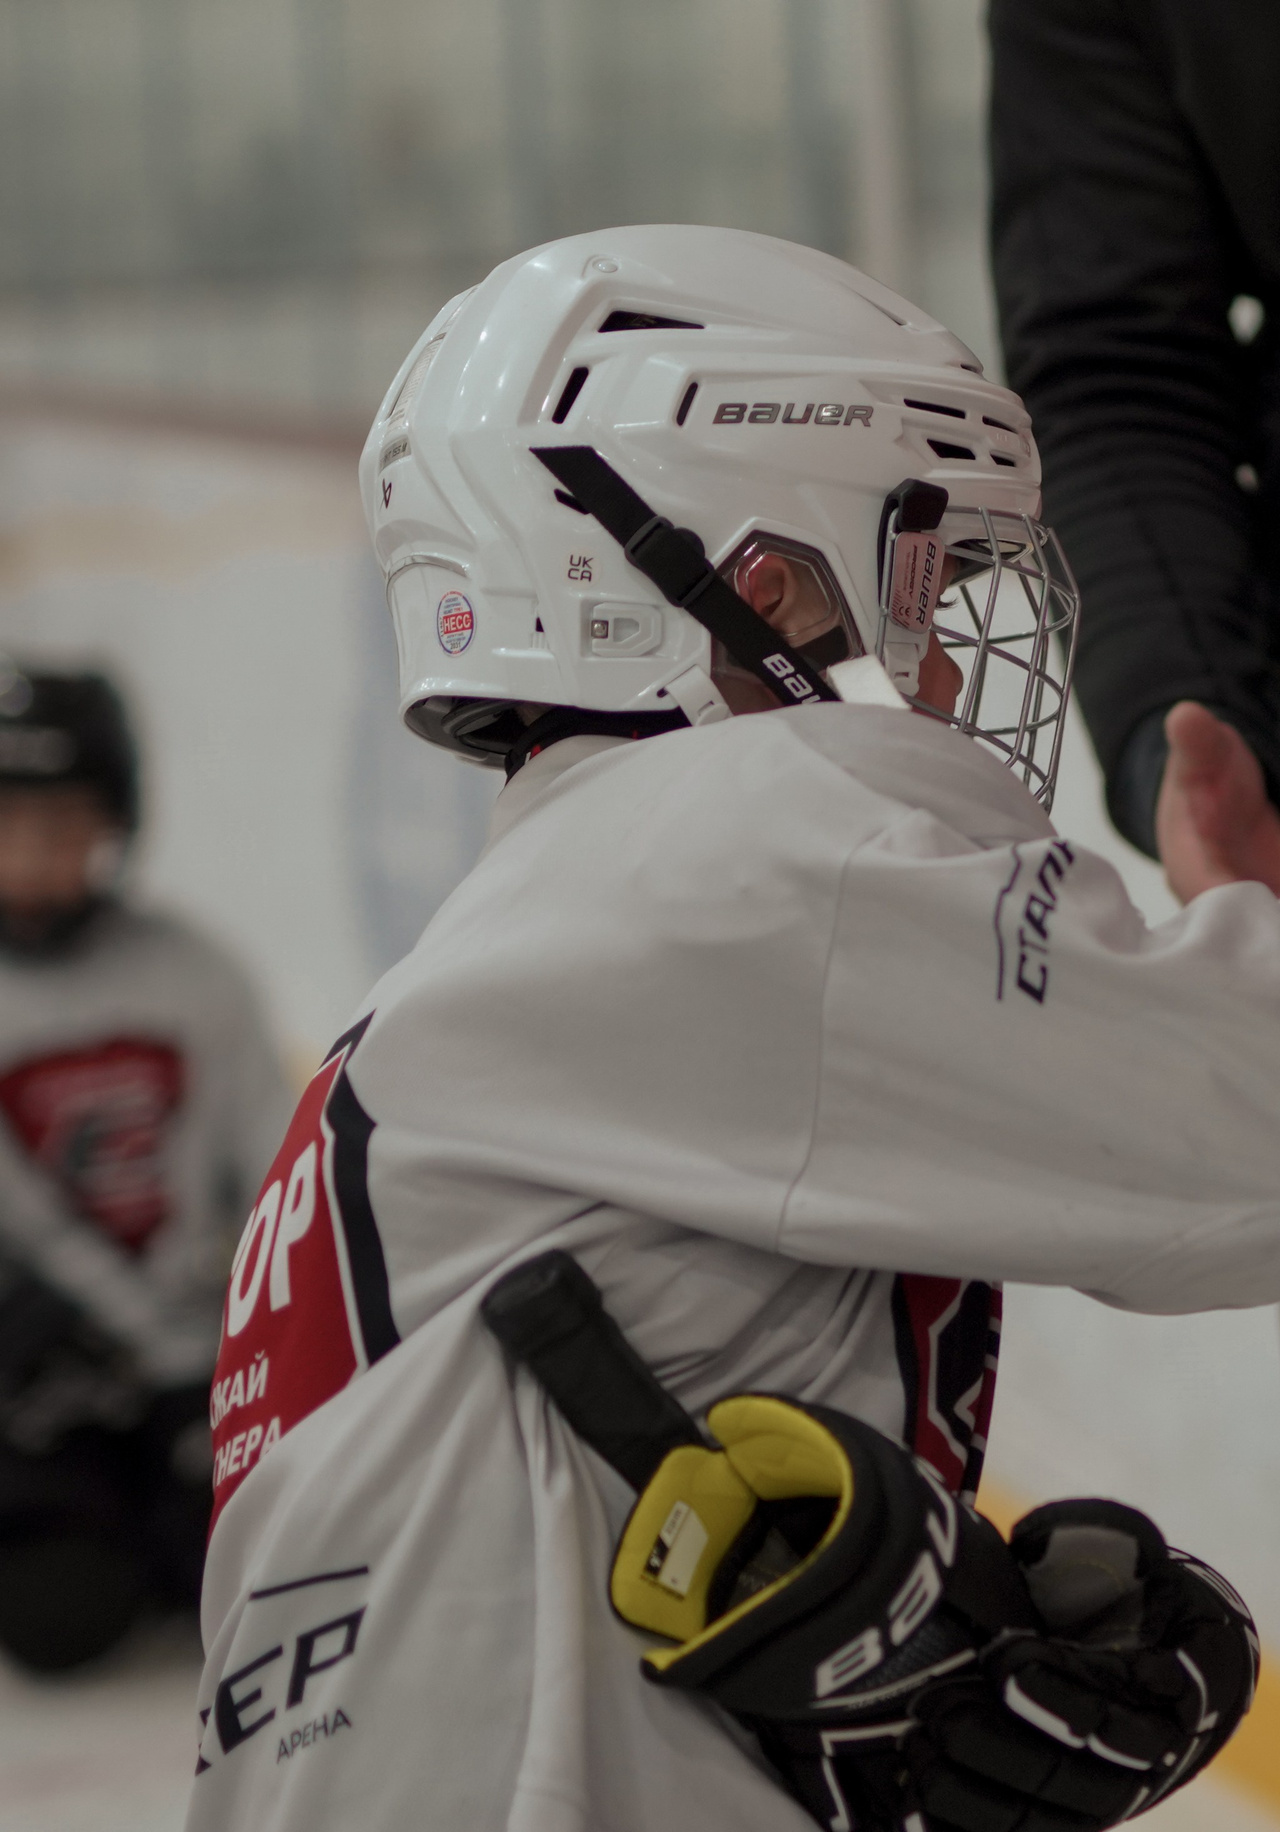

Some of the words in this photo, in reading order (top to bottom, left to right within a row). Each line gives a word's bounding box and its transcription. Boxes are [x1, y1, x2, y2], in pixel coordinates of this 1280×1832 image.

[712, 402, 874, 427] BAUER
[567, 567, 592, 582] CA
[569, 554, 594, 569] UK
[908, 544, 918, 600] PRODIGY
[916, 541, 937, 625] BAUER
[443, 613, 471, 633] HECC
[762, 653, 821, 704] BA
[209, 1349, 269, 1431] ЖАЙ
[276, 1706, 353, 1765] АРЕНА
